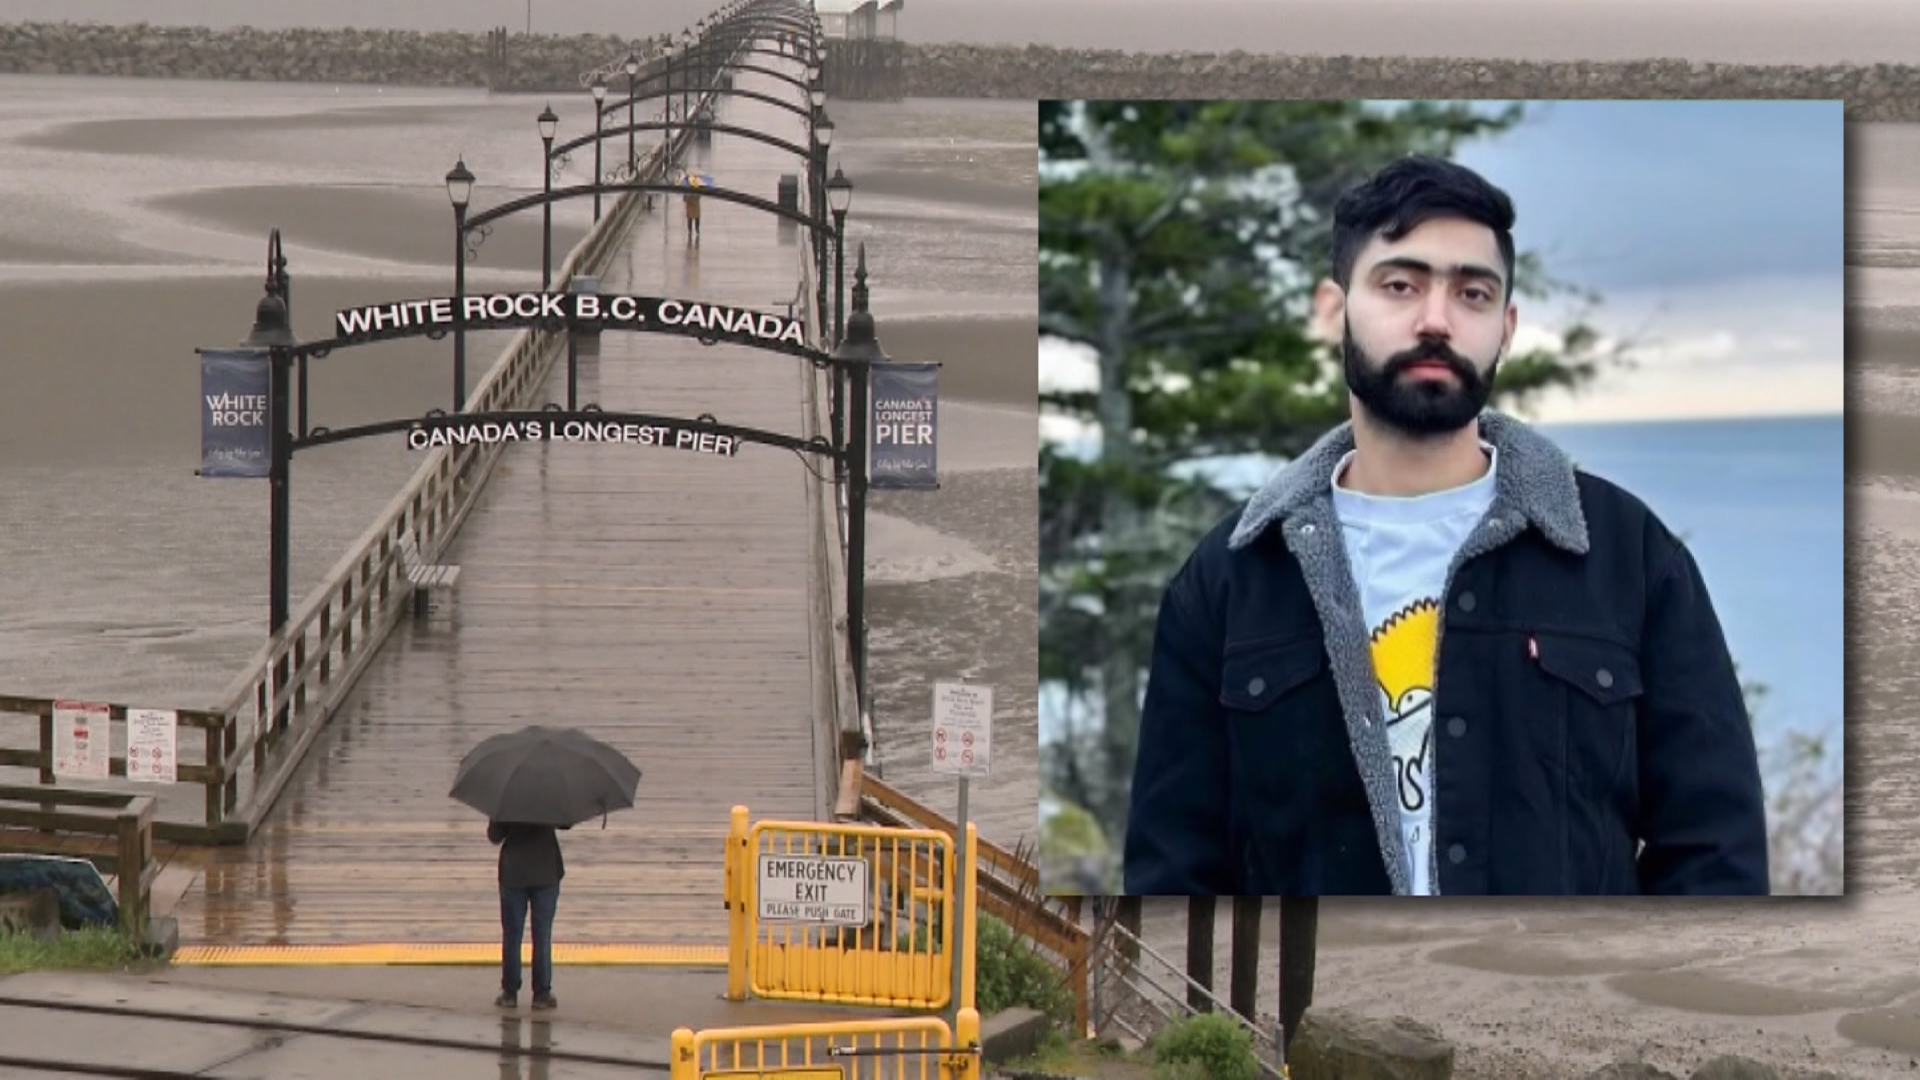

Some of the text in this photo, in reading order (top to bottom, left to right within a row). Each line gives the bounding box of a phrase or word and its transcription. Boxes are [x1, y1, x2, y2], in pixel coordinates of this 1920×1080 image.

[338, 293, 805, 344] WHITE ROCK B.C. CANADA
[206, 392, 266, 410] WHITE
[876, 399, 932, 410] CANADA'S
[213, 411, 263, 426] ROCK
[876, 411, 932, 422] LONGEST
[408, 420, 735, 456] CANADA'S LONGEST PIER
[876, 423, 933, 444] PIER
[767, 860, 857, 882] EMERGENCY
[796, 883, 828, 902] EXIT
[767, 903, 857, 920] PLEASE PUSH GATE
